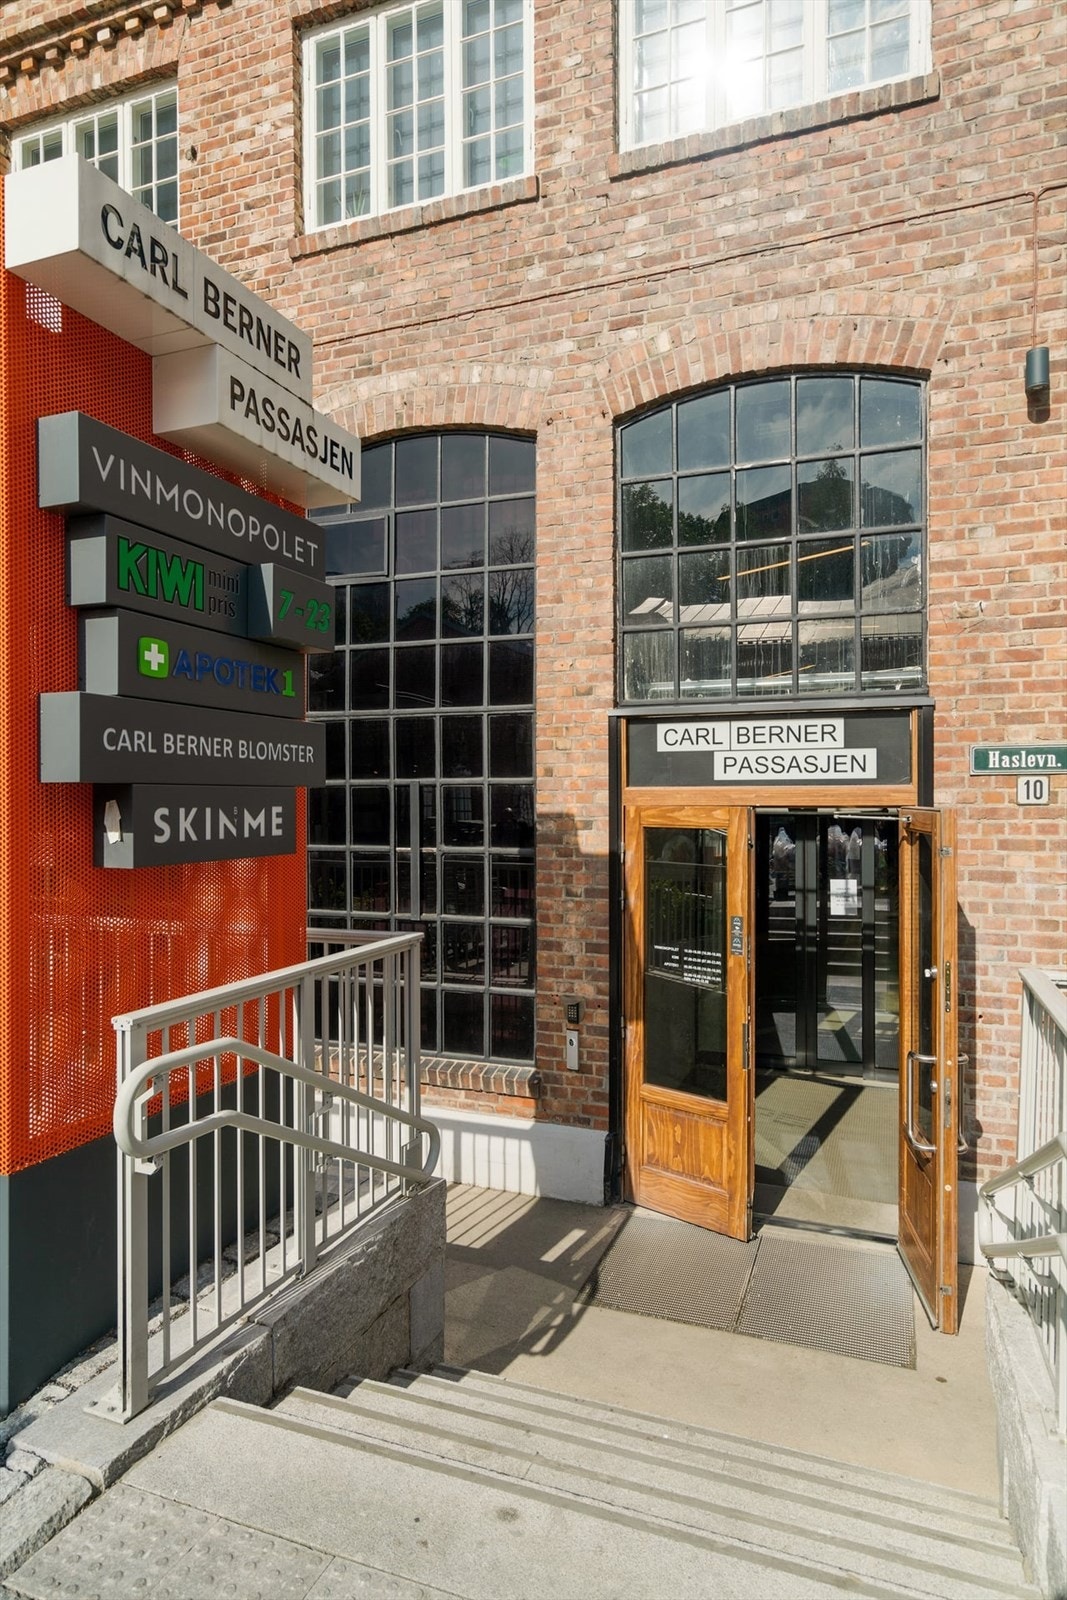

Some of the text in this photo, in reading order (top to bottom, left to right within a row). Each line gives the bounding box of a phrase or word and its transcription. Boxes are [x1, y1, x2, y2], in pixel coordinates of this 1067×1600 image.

[101, 203, 301, 380] CARL BERNER
[229, 375, 354, 480] PASSASJEN
[91, 445, 319, 568] VINMONOPOLET
[117, 535, 205, 613] KIWI
[208, 569, 240, 594] mini
[208, 594, 237, 618] pris
[103, 727, 315, 763] CARL BERNER BLOMSTER
[663, 723, 838, 746] CARL BERNER
[723, 754, 867, 774] PASSASJEN
[987, 750, 1062, 768] Haslevn.
[1023, 779, 1044, 800] 10
